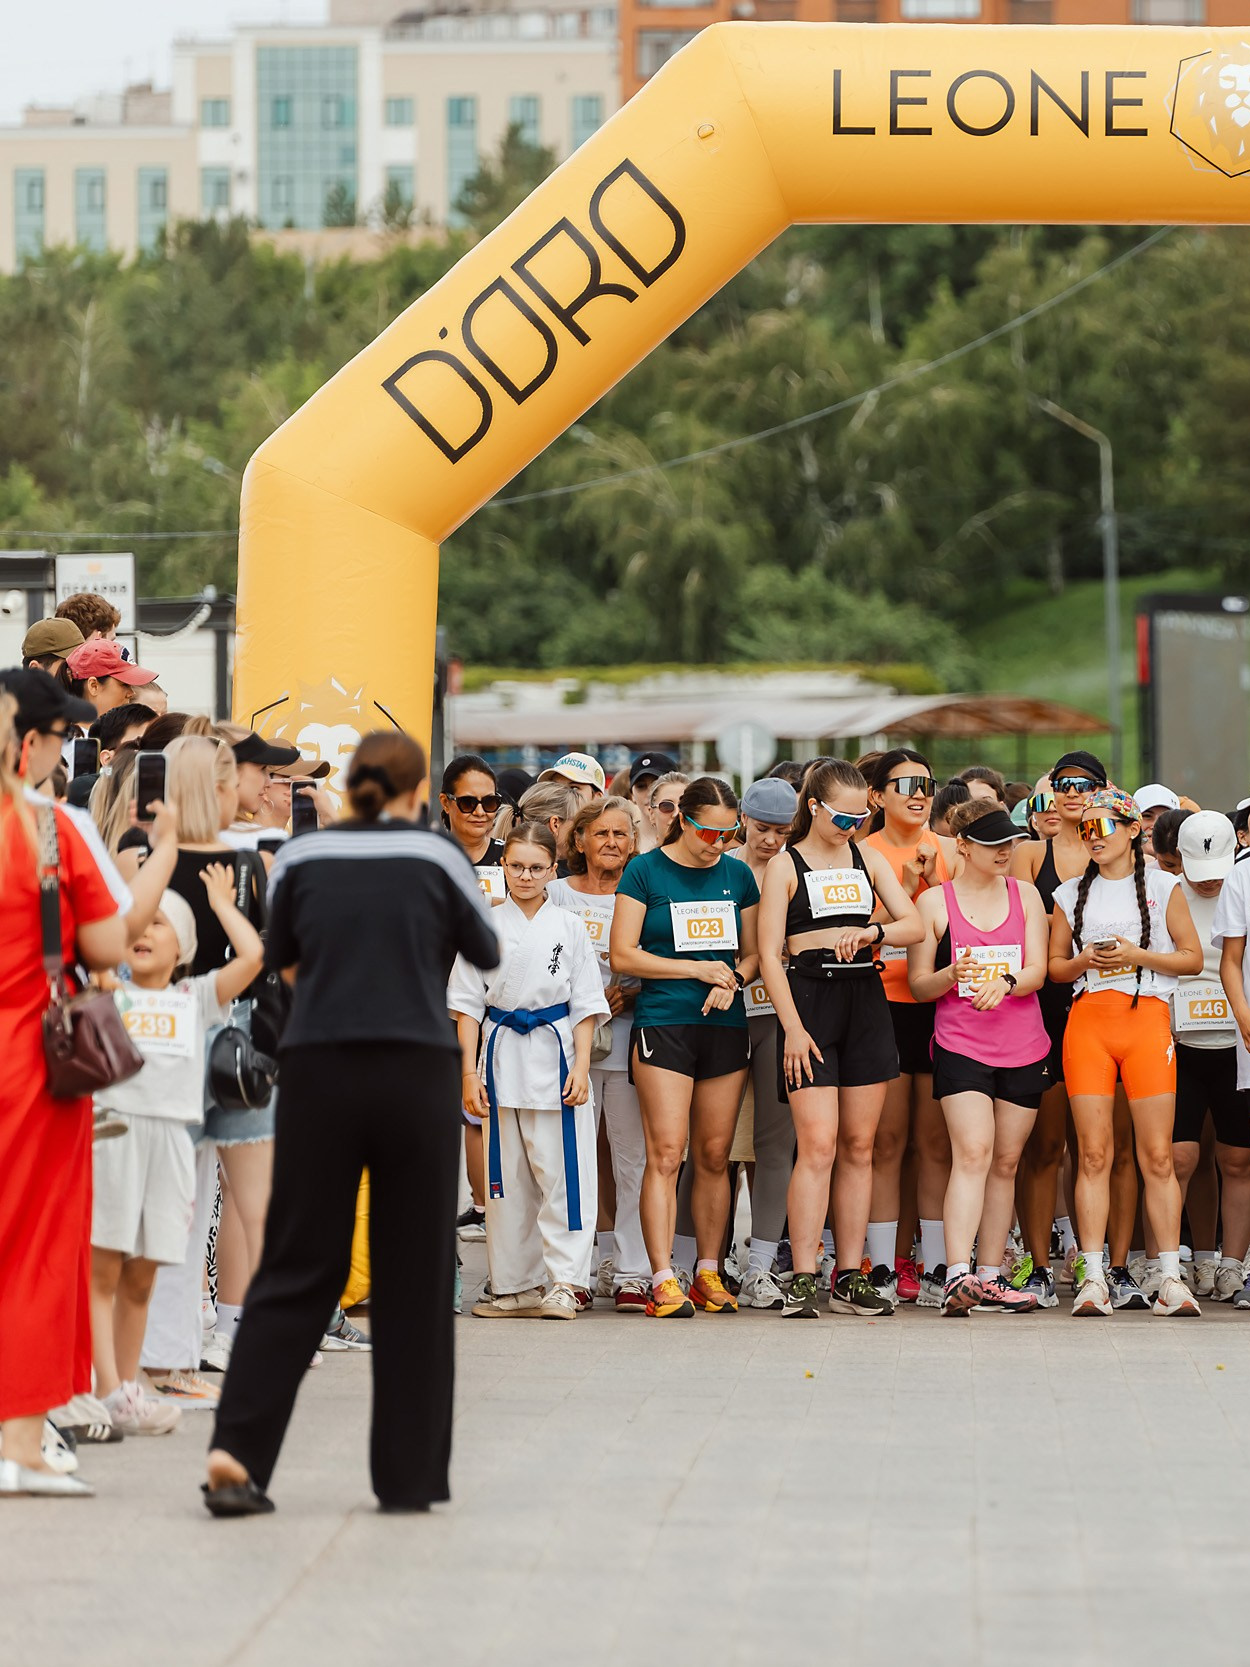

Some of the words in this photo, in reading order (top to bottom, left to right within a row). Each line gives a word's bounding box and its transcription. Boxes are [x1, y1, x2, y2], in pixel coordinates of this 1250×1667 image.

[832, 69, 1149, 138] LEONE
[381, 157, 687, 466] D'ORO
[827, 885, 858, 901] 486
[677, 907, 700, 915] LEONE
[690, 920, 721, 937] 023
[1179, 989, 1203, 998] LEONE
[1193, 1001, 1224, 1017] 446
[127, 1015, 172, 1035] 239
